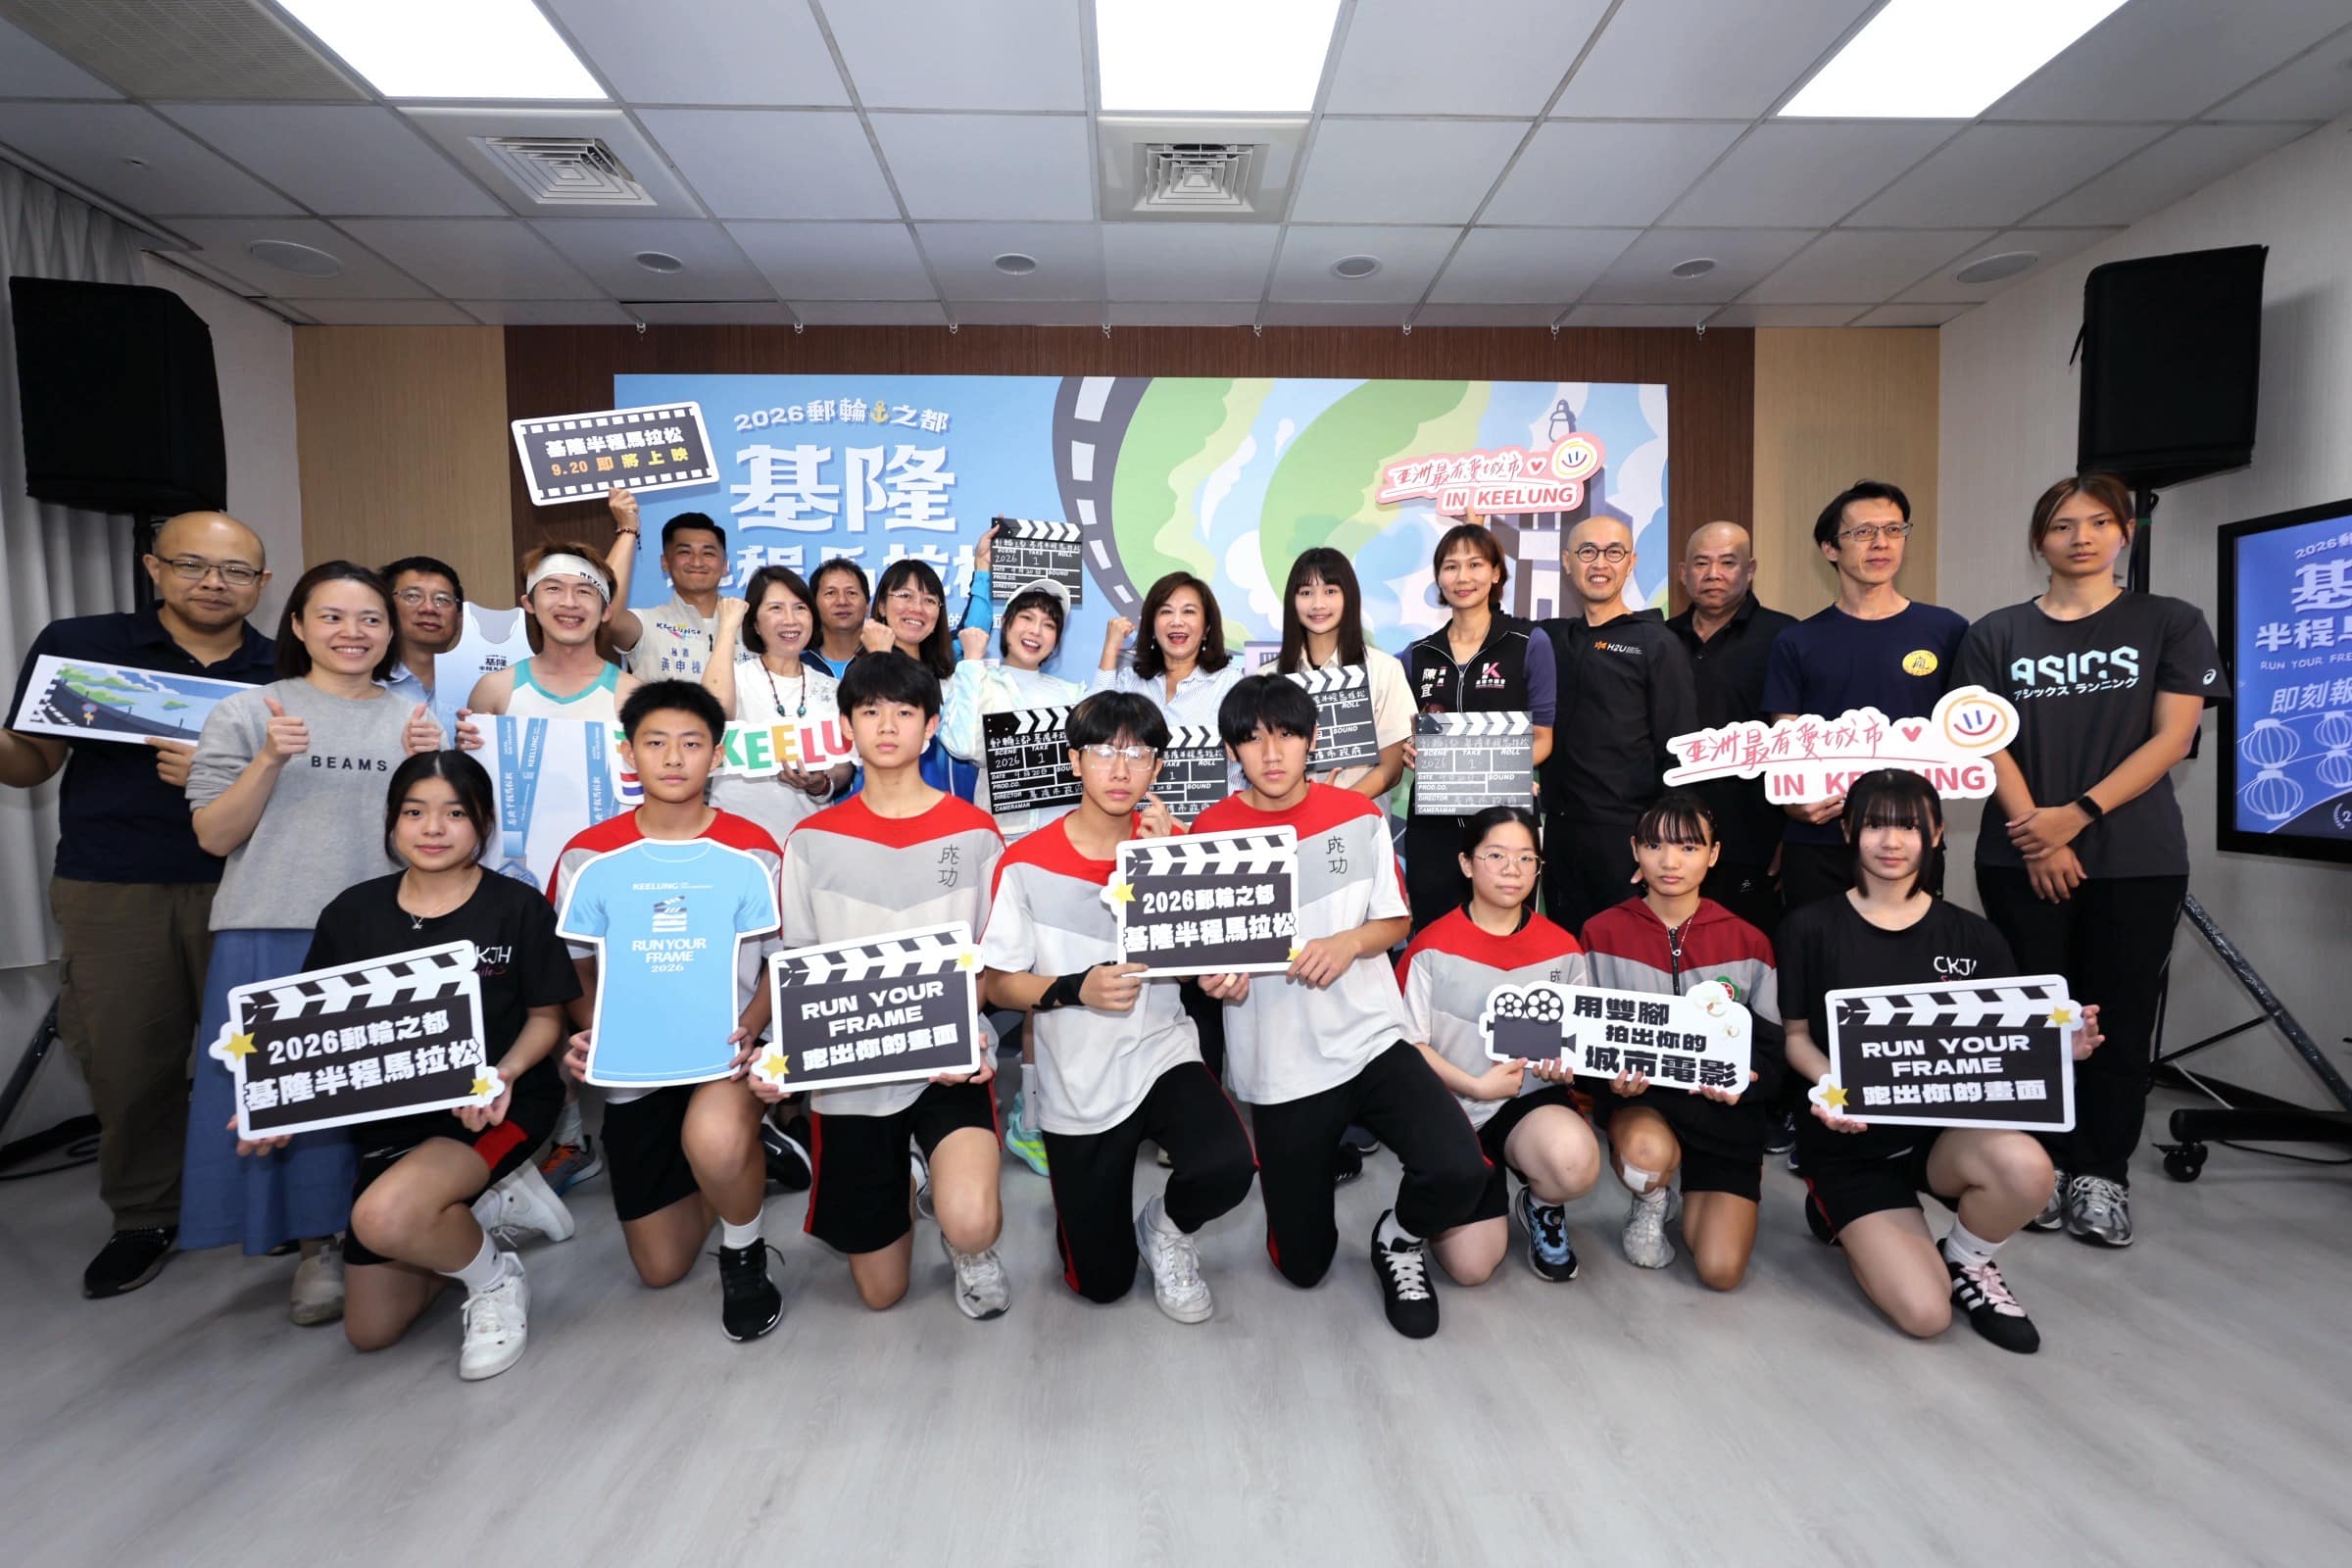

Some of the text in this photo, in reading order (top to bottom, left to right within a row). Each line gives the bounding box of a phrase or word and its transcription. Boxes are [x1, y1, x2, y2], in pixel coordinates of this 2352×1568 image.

[545, 426, 685, 458] 基隆半程馬拉松
[551, 461, 588, 476] 9.20
[729, 444, 956, 532] 基隆
[1446, 487, 1574, 507] IN KEELUNG
[2255, 615, 2352, 653] 半程
[2011, 646, 2139, 686] ASICS
[2260, 661, 2286, 670] RUN
[2291, 657, 2323, 669] YOUR
[2014, 677, 2139, 701] アシックス ランニング
[1333, 725, 1358, 734] SOUND
[312, 755, 388, 772] BEAMS
[996, 753, 1045, 768] 2026 1
[994, 792, 1022, 801] DIRECTOR
[1773, 774, 1804, 797] IN
[995, 803, 1030, 812] CAMERAMAN
[937, 844, 961, 889] 成功
[1326, 835, 1348, 875] 成功
[1142, 884, 1275, 915] 2026郵輪之都
[632, 937, 707, 952] RUN YOUR
[1123, 912, 1298, 954] 基隆半程馬拉松
[475, 946, 512, 964] KJH
[645, 951, 695, 963] FRAME
[651, 963, 684, 973] 2026
[801, 980, 944, 1020] RUN YOUR
[1573, 994, 1670, 1026] 用雙腳
[828, 1004, 923, 1038] FRAME
[267, 1009, 450, 1065] 2026郵輪之都
[802, 1022, 958, 1072] 跑出你的畫面
[1605, 1023, 1707, 1053] 拍出你的
[1861, 1035, 2031, 1058] RUN YOUR
[242, 1037, 483, 1111] 基隆半程馬拉松
[1585, 1044, 1739, 1089] 城市電影
[1891, 1056, 2004, 1078] FRAME
[1862, 1079, 2047, 1106] 跑出你的畫面
